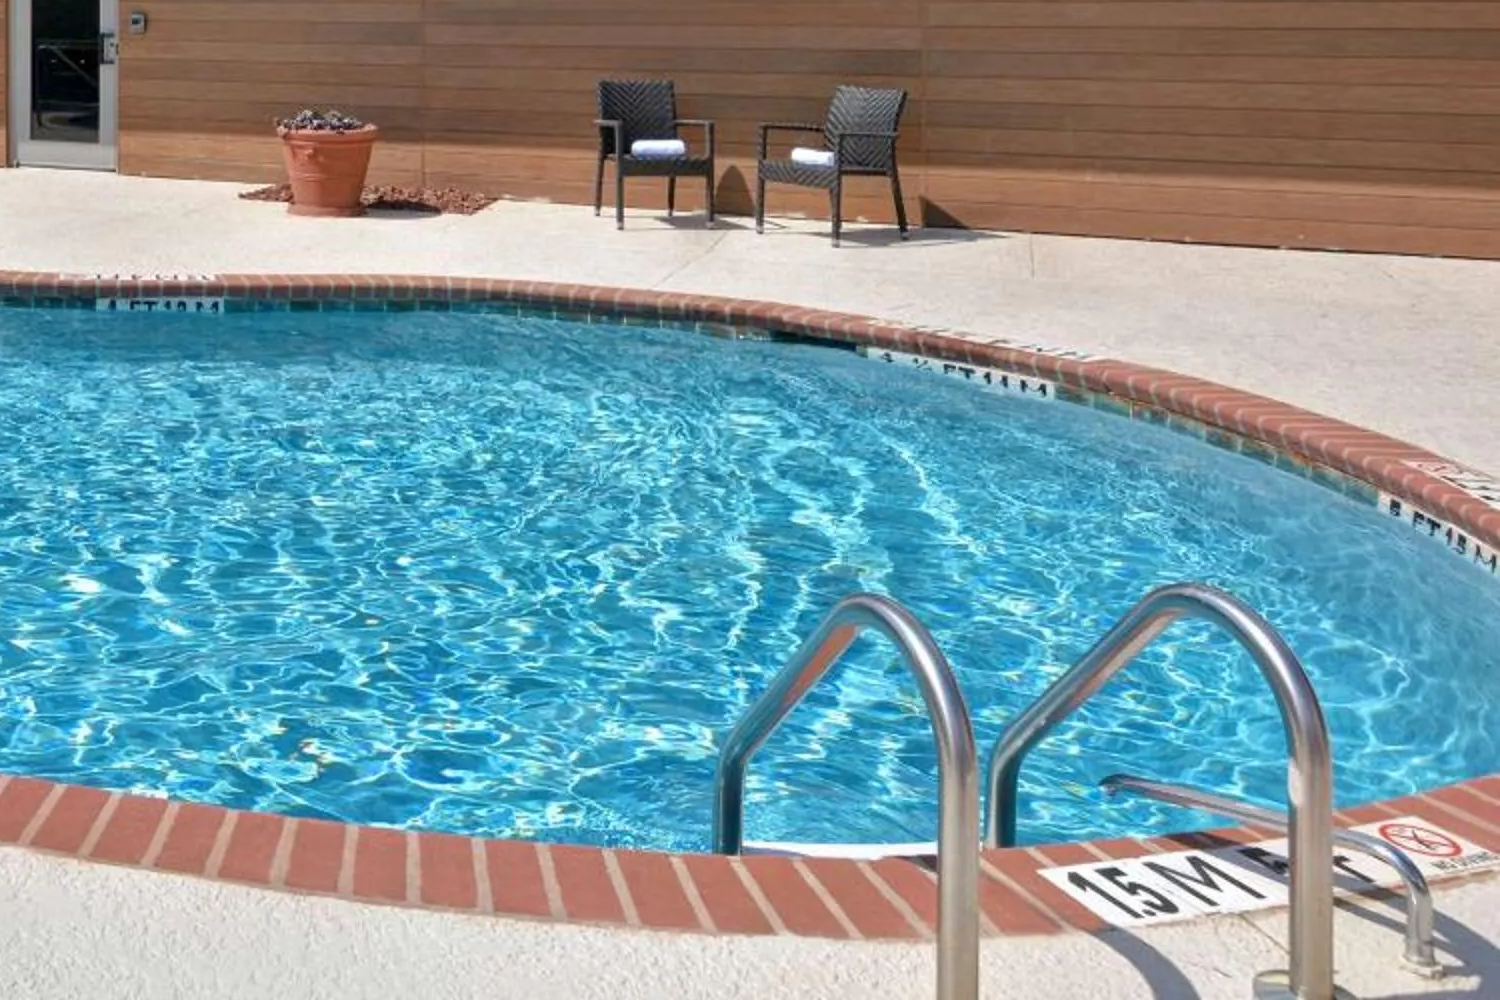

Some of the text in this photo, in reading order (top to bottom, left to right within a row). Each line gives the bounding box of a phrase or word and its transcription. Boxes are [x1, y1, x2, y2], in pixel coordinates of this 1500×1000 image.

[1412, 511, 1442, 537] FT
[1474, 544, 1497, 573] M
[1144, 855, 1268, 907] M
